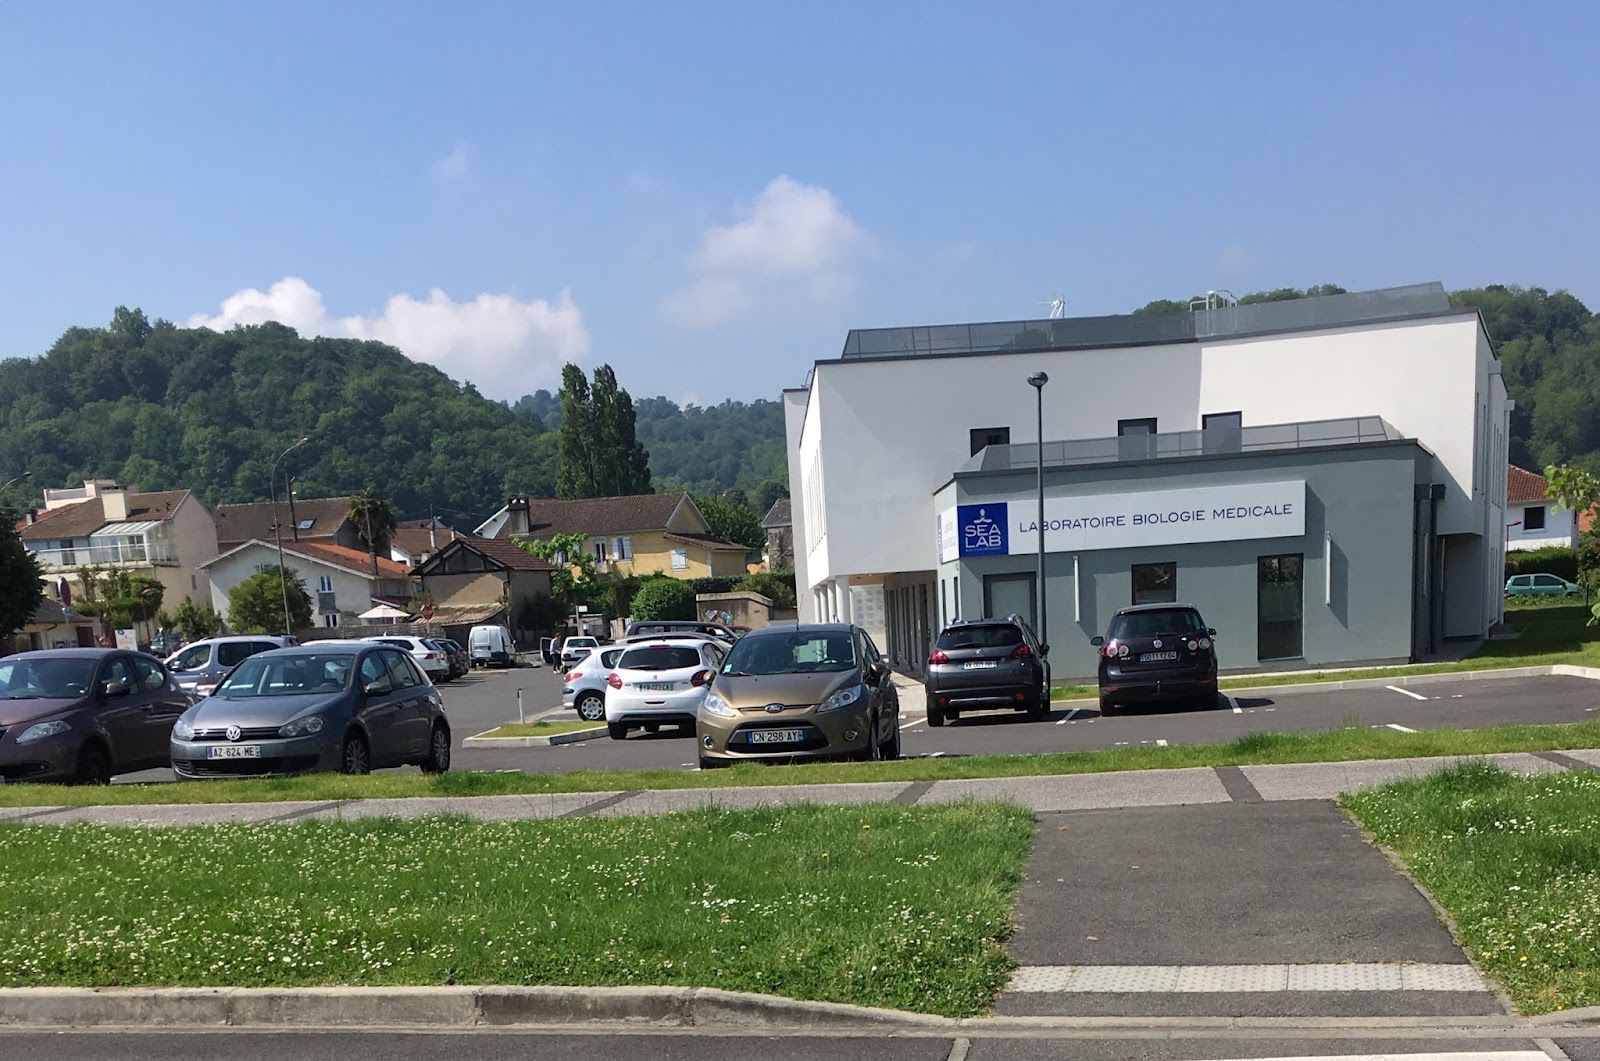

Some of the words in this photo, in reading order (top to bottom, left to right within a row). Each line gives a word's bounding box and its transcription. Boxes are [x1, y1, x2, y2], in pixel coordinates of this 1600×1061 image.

[1019, 515, 1126, 533] LABORATOIRE
[1132, 510, 1206, 526] BIOLOGIE
[1212, 503, 1293, 520] MEDICALE
[964, 523, 1001, 537] SEA
[964, 535, 1002, 549] LAB
